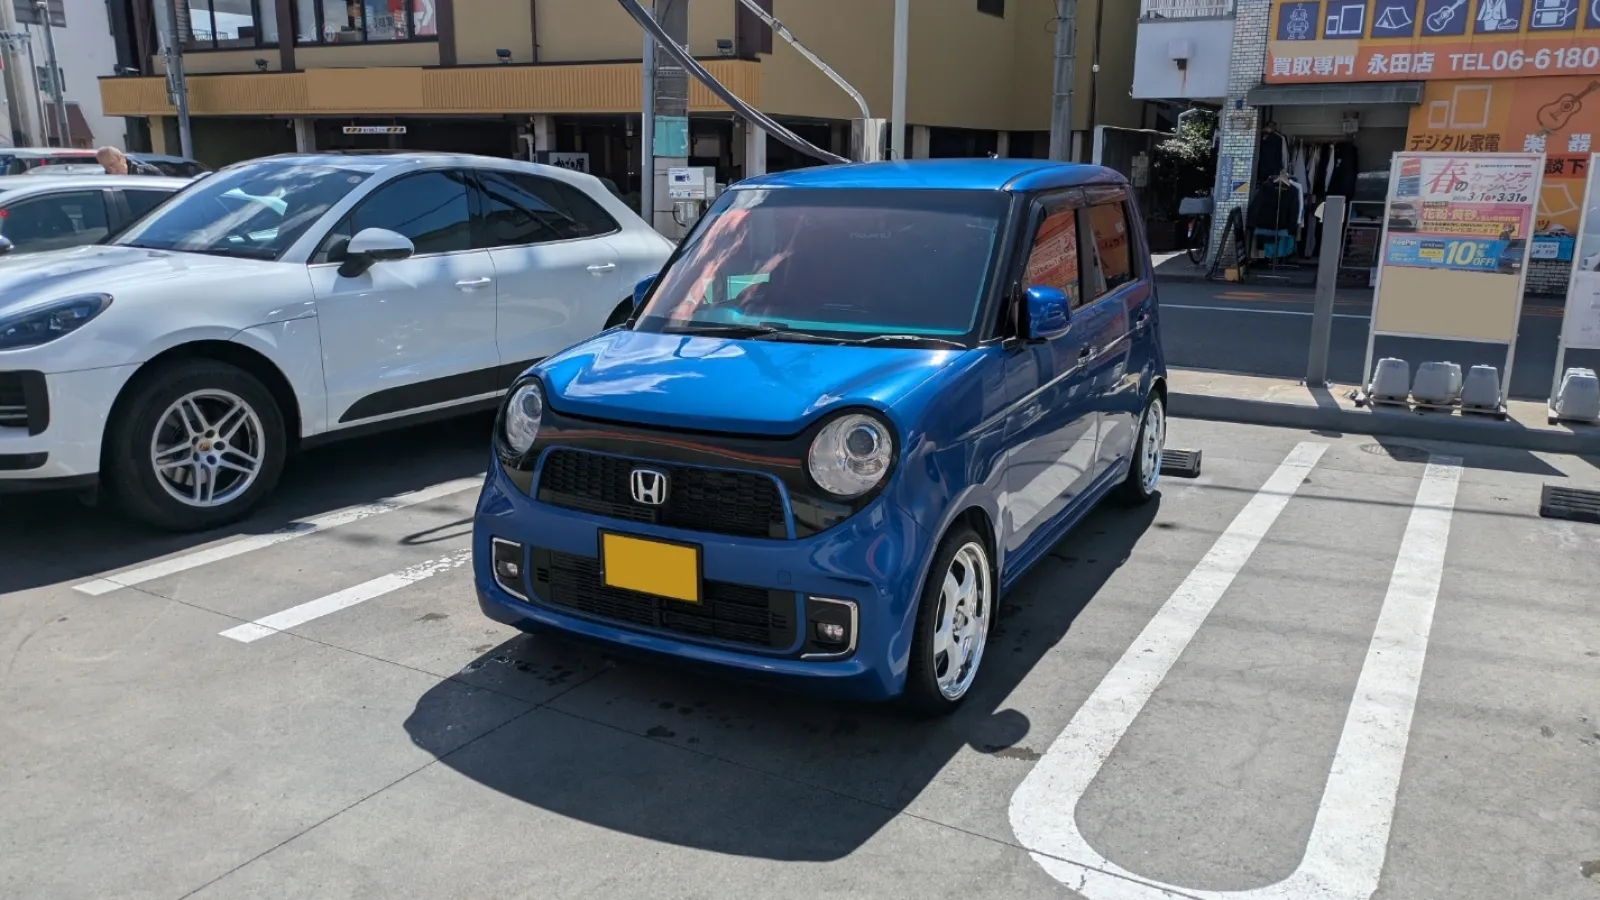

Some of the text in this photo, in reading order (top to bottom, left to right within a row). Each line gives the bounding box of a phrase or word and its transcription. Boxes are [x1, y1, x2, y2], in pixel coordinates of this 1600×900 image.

[1271, 52, 1435, 77] 買取専門 永田店
[1410, 133, 1500, 152] デジタル家電
[1469, 171, 1532, 183] カーメンテ
[1468, 183, 1528, 193] キャンペーン
[1446, 240, 1477, 265] 10
[1473, 257, 1495, 266] OFF!
